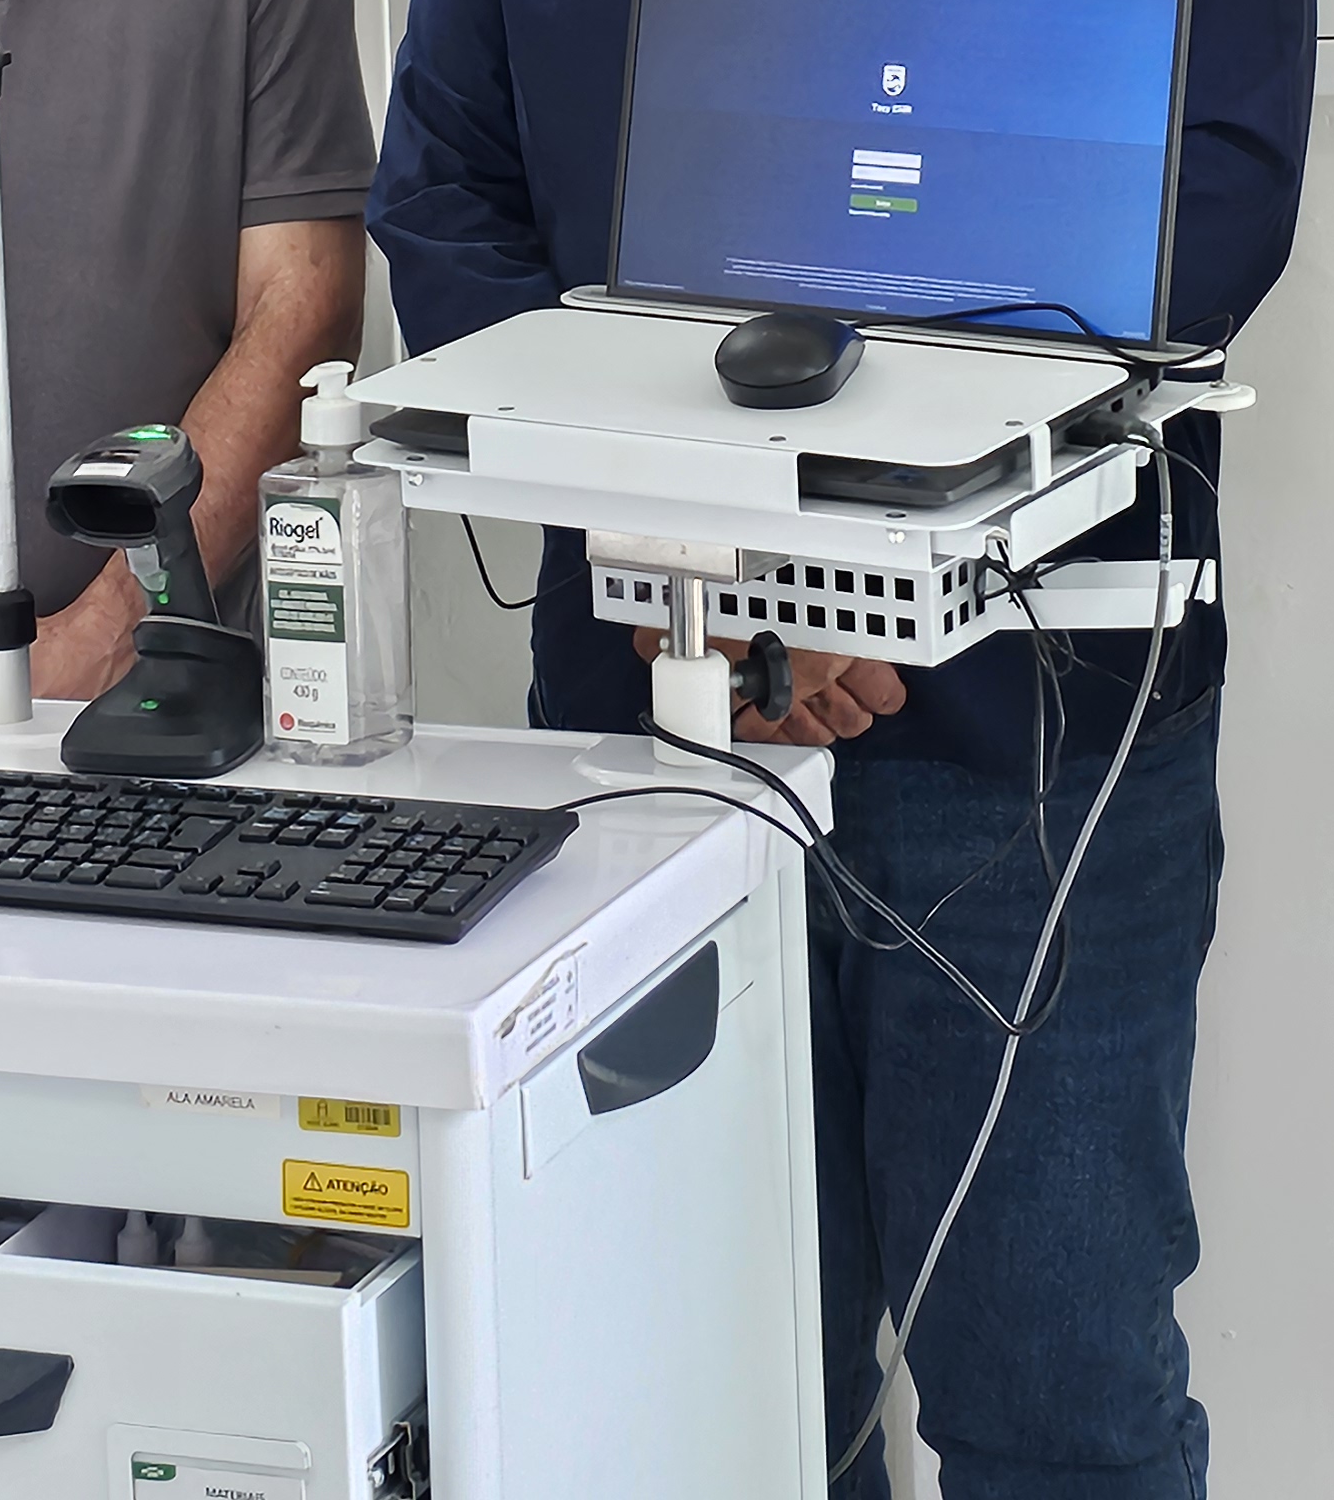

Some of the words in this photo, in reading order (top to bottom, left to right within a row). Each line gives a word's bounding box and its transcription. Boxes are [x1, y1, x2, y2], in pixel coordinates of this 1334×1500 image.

[269, 516, 321, 543] Riogel
[166, 1091, 192, 1105] ALA
[194, 1093, 255, 1109] AMARELA
[327, 1179, 389, 1196] ATENÇÃO
